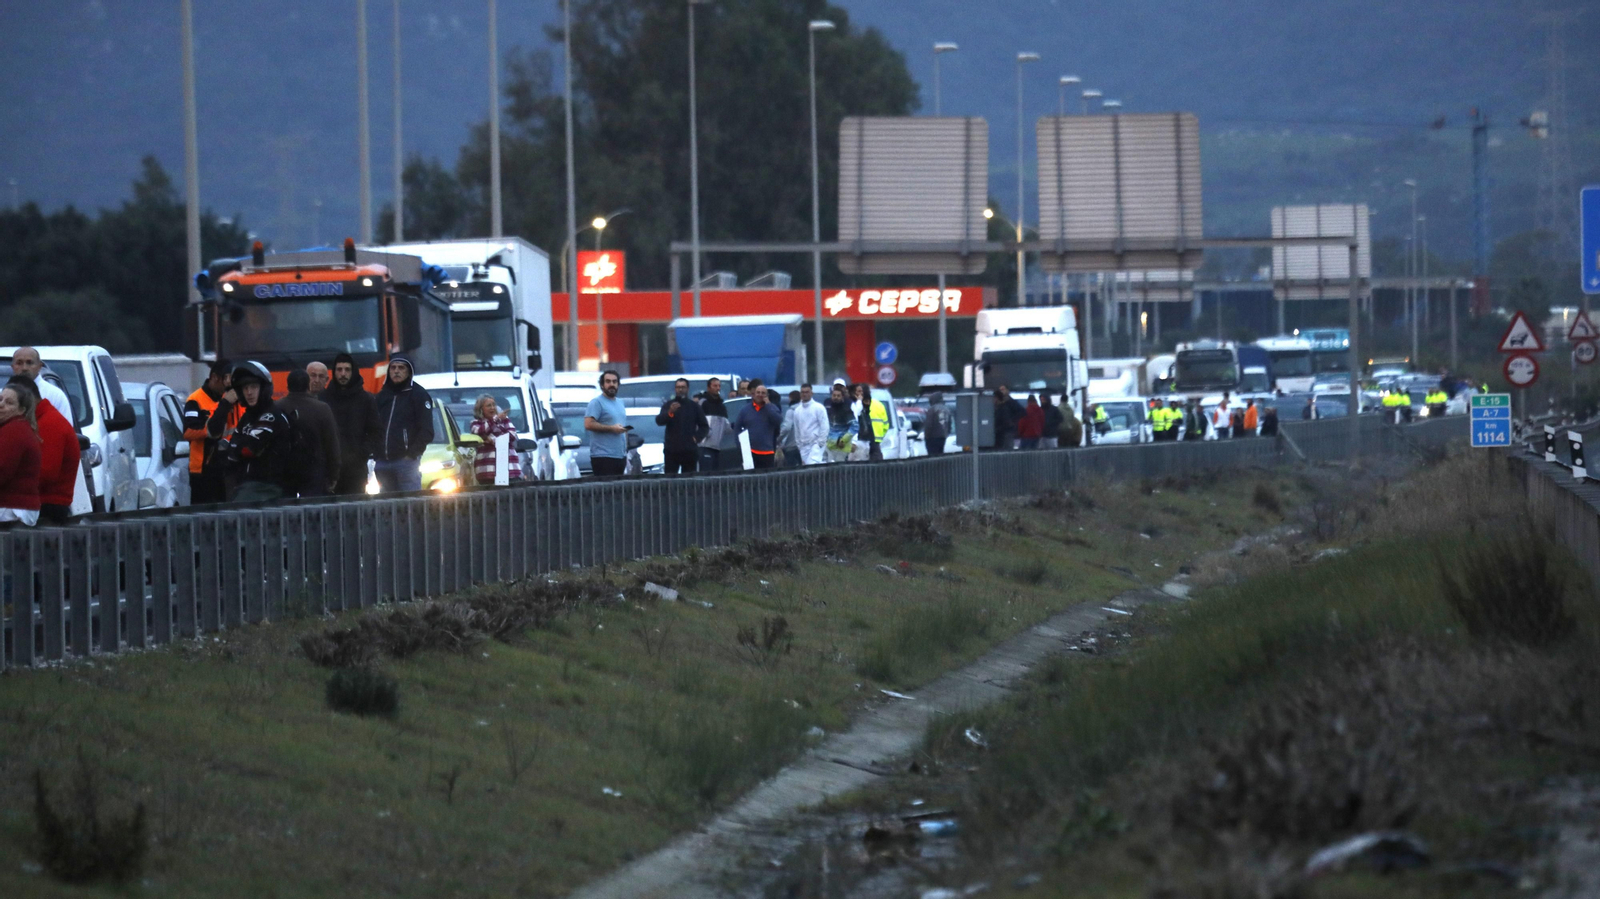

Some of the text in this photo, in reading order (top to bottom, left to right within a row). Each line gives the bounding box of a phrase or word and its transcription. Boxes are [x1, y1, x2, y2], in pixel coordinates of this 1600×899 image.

[858, 289, 962, 314] CEPSA
[1480, 397, 1500, 405] E-15
[1483, 409, 1499, 417] A-7
[1477, 432, 1505, 443] 1114
